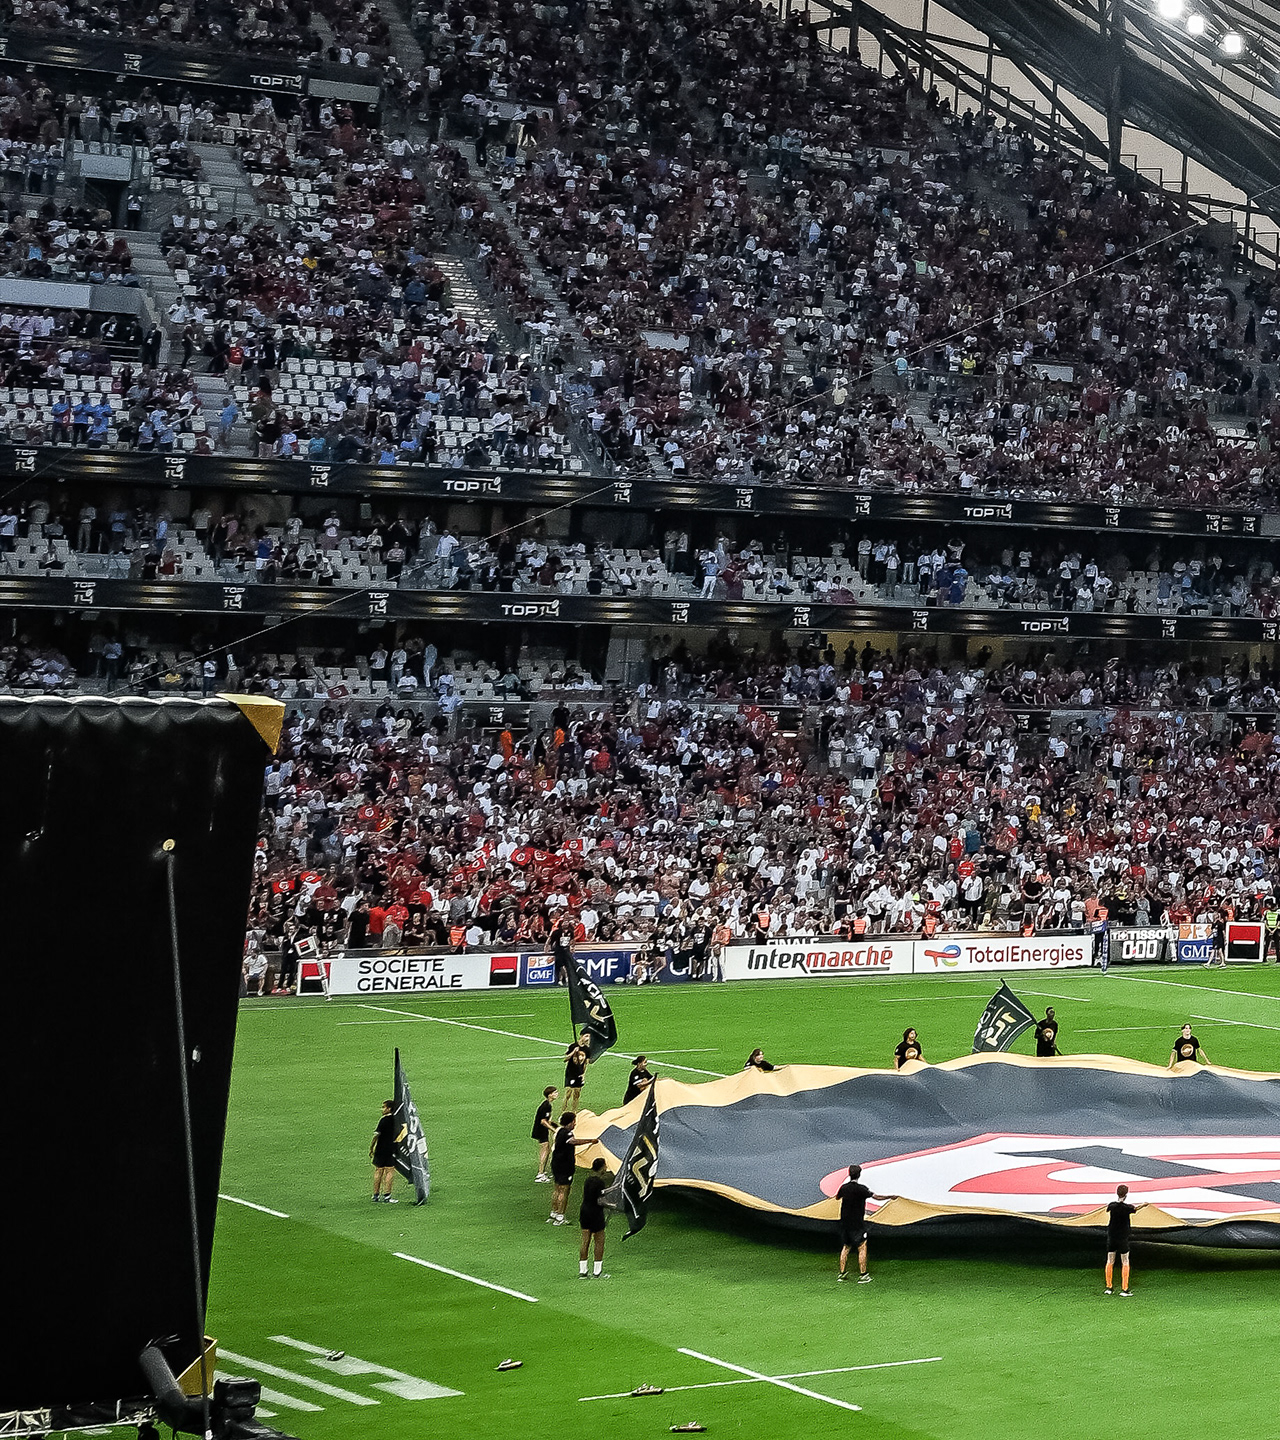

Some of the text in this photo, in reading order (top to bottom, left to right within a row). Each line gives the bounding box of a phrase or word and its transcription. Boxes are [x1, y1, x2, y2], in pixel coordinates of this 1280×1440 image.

[966, 943, 1083, 965] TotalEnergies
[1181, 944, 1213, 958] GMF
[358, 958, 445, 975] SOCIETE
[528, 968, 553, 980] GMF
[357, 974, 463, 992] GENERALE
